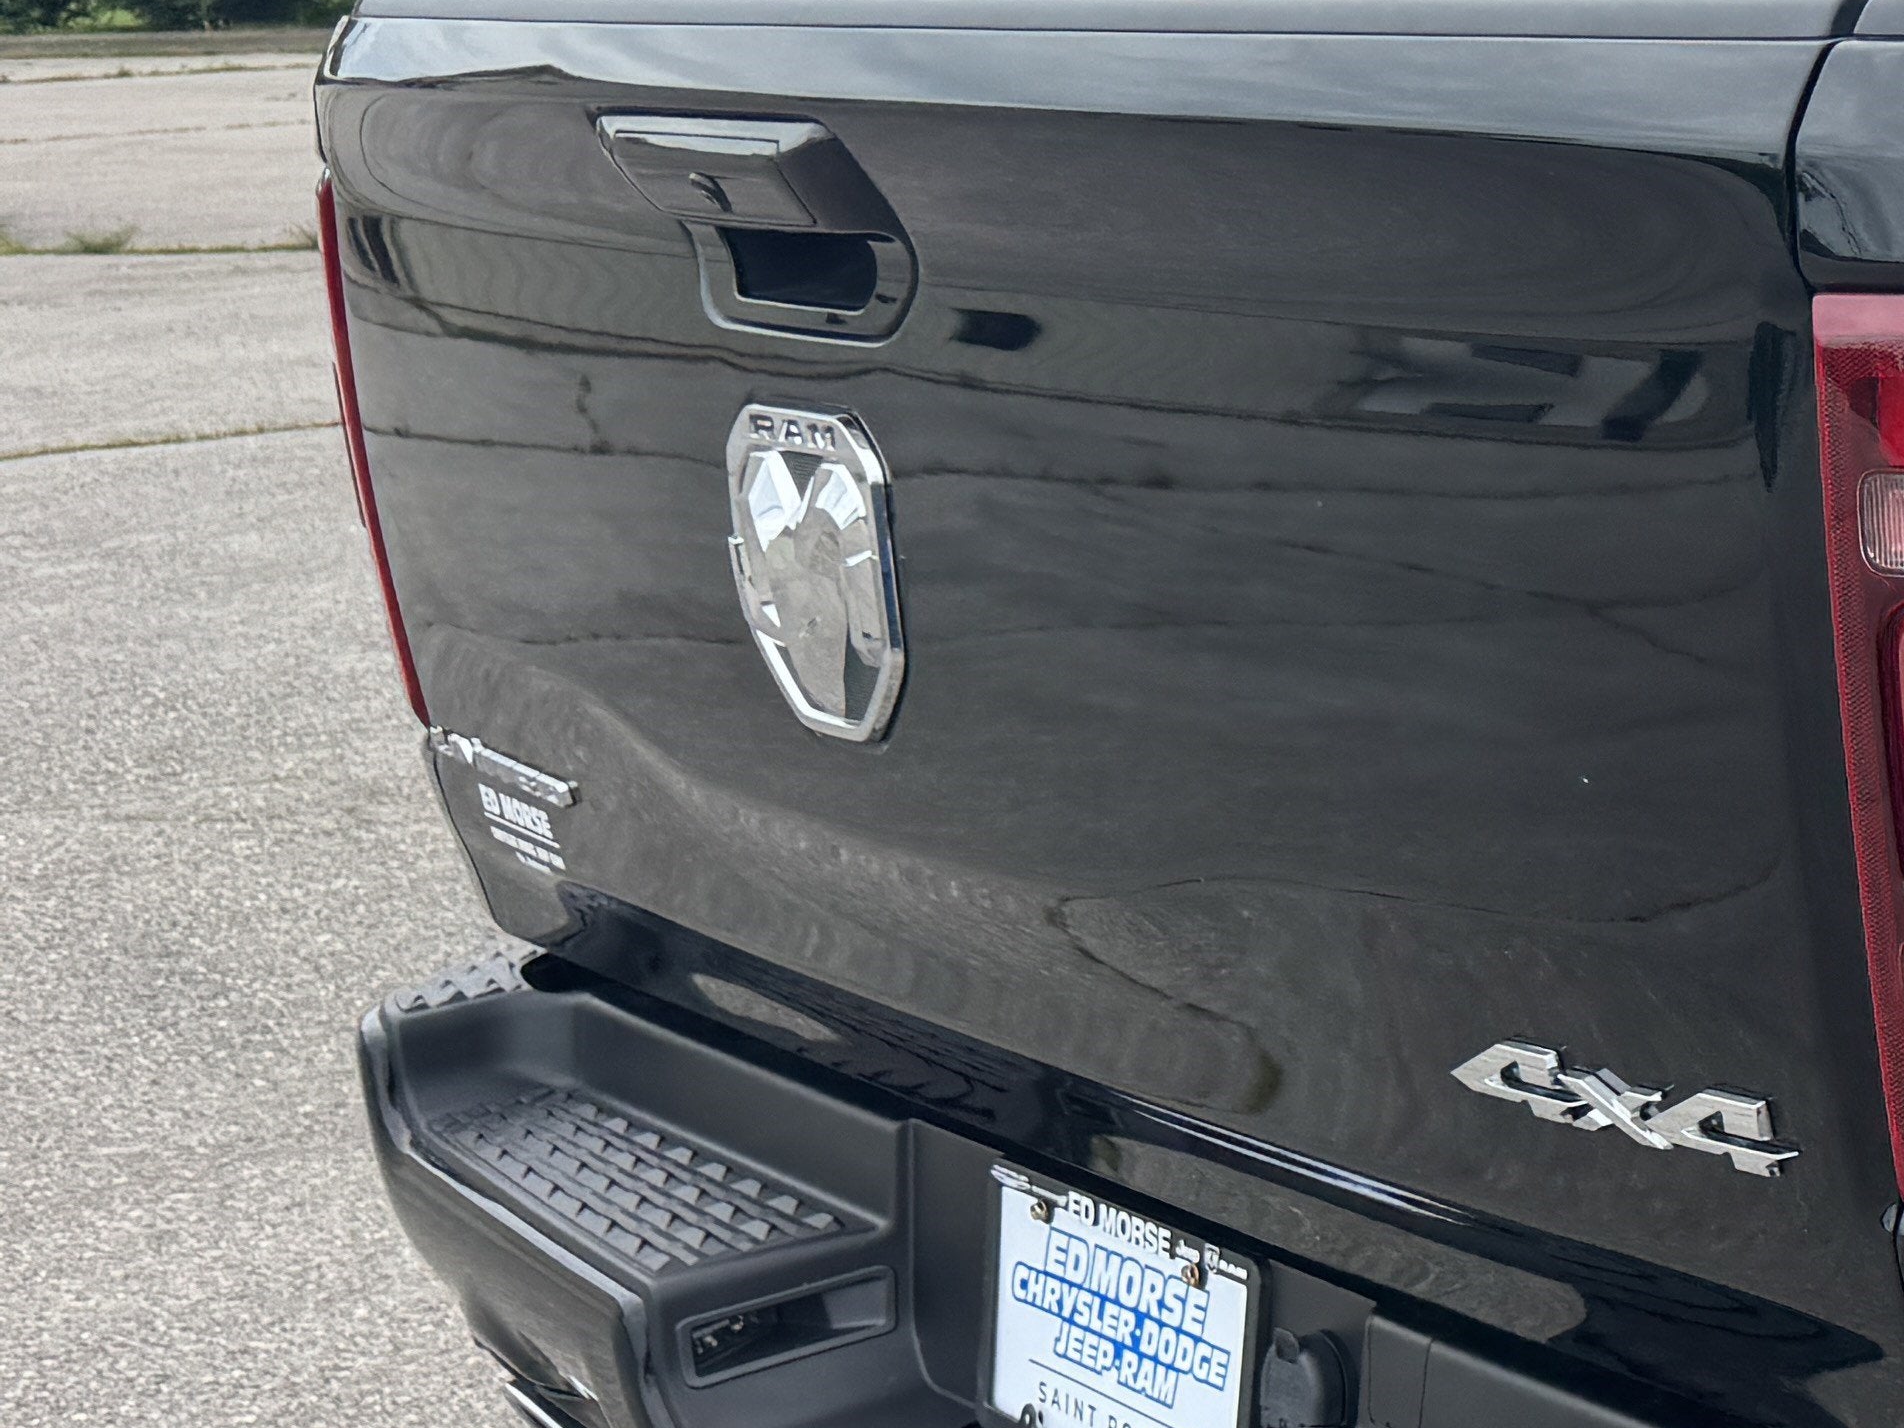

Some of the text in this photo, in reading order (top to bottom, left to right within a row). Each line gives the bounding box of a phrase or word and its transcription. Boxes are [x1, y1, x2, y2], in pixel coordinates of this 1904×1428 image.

[749, 414, 836, 452] RAM
[1067, 1190, 1096, 1227] ED
[1099, 1203, 1173, 1259] MORSE
[1046, 1228, 1089, 1289] ED
[1088, 1245, 1210, 1335] MORSE
[1038, 1381, 1097, 1427] SAINT
